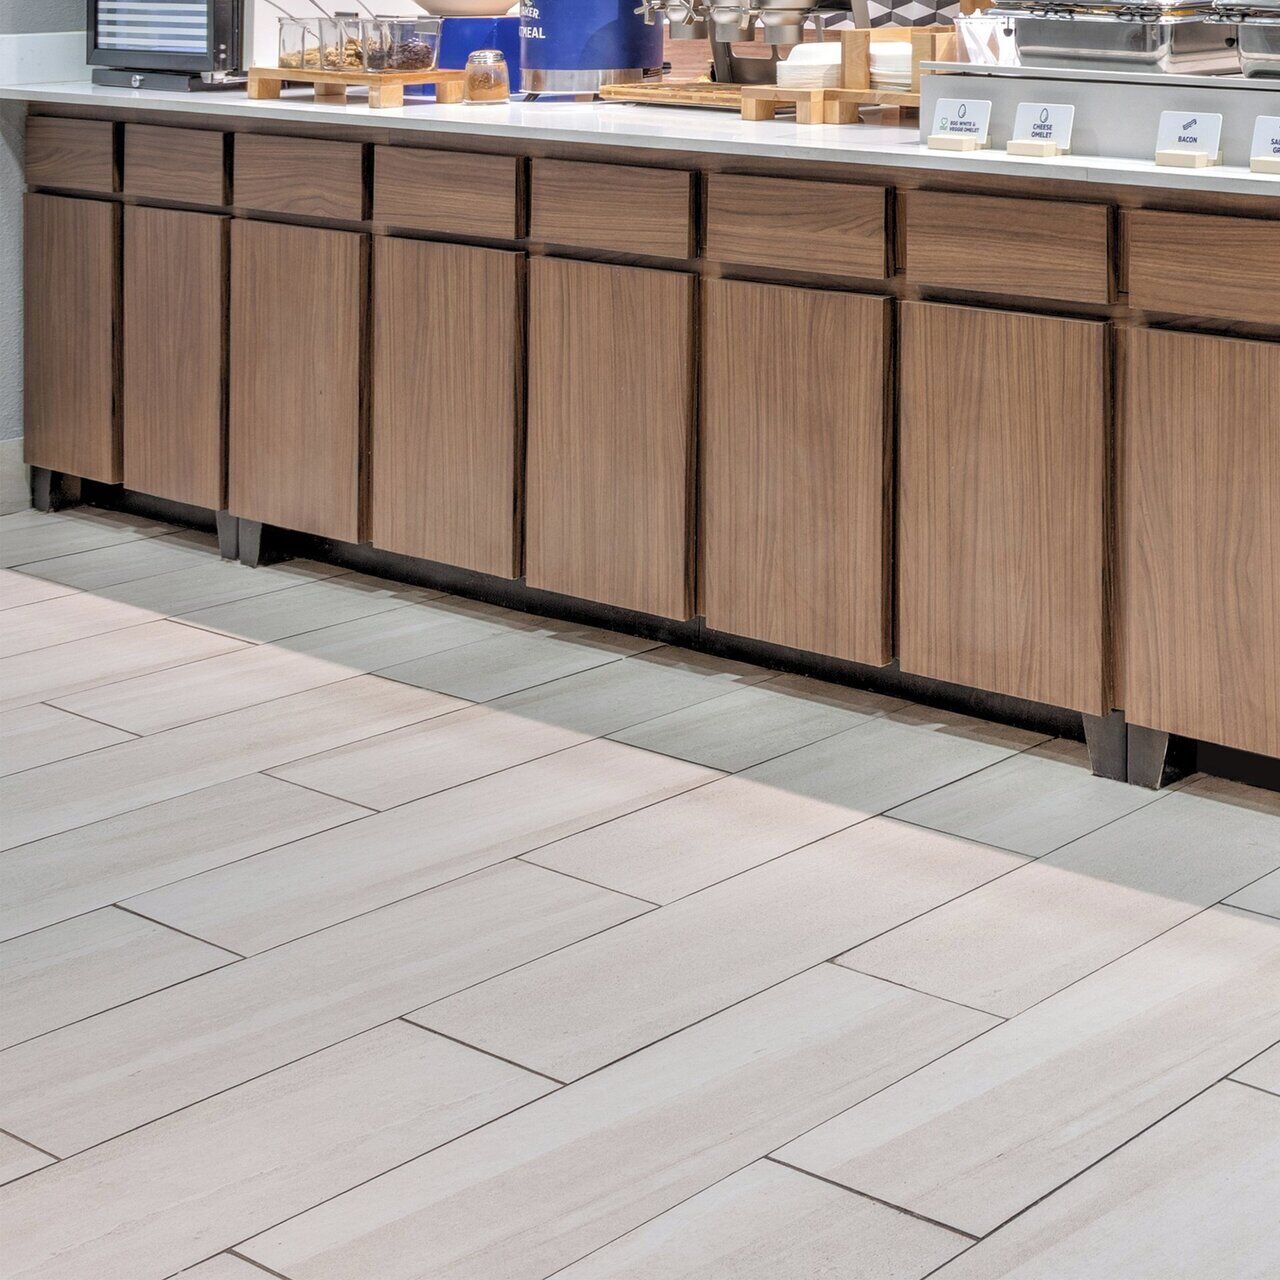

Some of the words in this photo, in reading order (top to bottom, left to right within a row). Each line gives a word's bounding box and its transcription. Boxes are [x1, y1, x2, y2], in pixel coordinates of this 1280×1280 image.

[1032, 123, 1053, 131] CHEESE
[1031, 131, 1053, 139] OMELET
[1178, 135, 1198, 144] BACON
